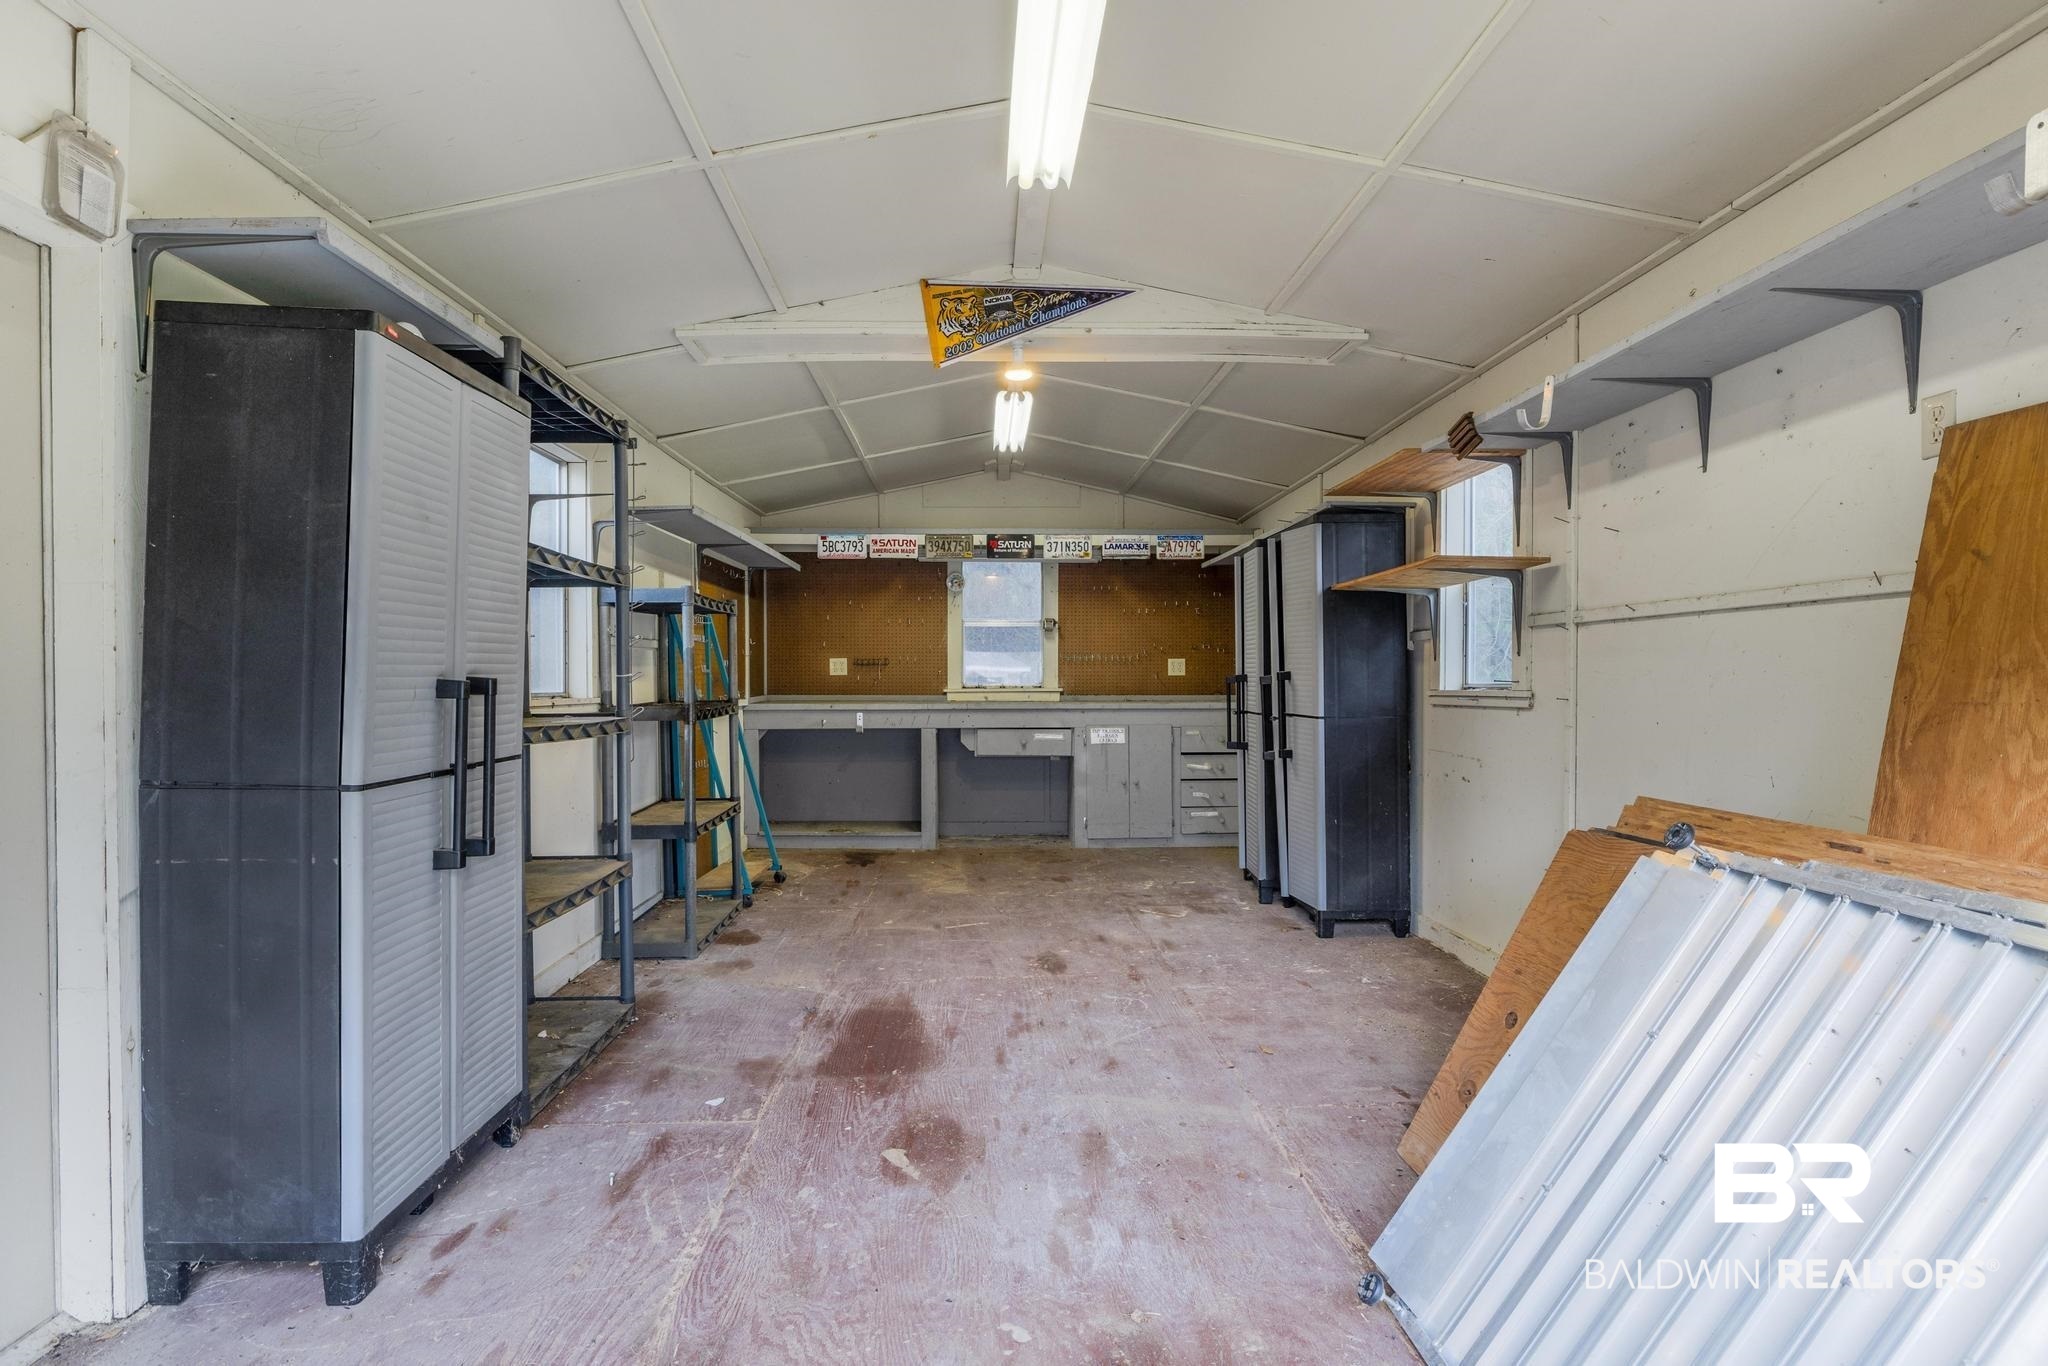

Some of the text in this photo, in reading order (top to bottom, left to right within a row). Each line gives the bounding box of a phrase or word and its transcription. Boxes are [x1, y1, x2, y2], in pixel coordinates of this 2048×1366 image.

[984, 294, 1012, 305] NOKIA
[1049, 291, 1072, 305] Tigers
[944, 296, 1087, 358] 2003 National Champions
[822, 540, 864, 553] 5BC3793
[879, 539, 917, 548] SATURN
[928, 540, 971, 553] 394X750
[997, 540, 1032, 549] SATURN
[1046, 541, 1089, 553] 371N350
[1104, 543, 1149, 551] LAMARQUE
